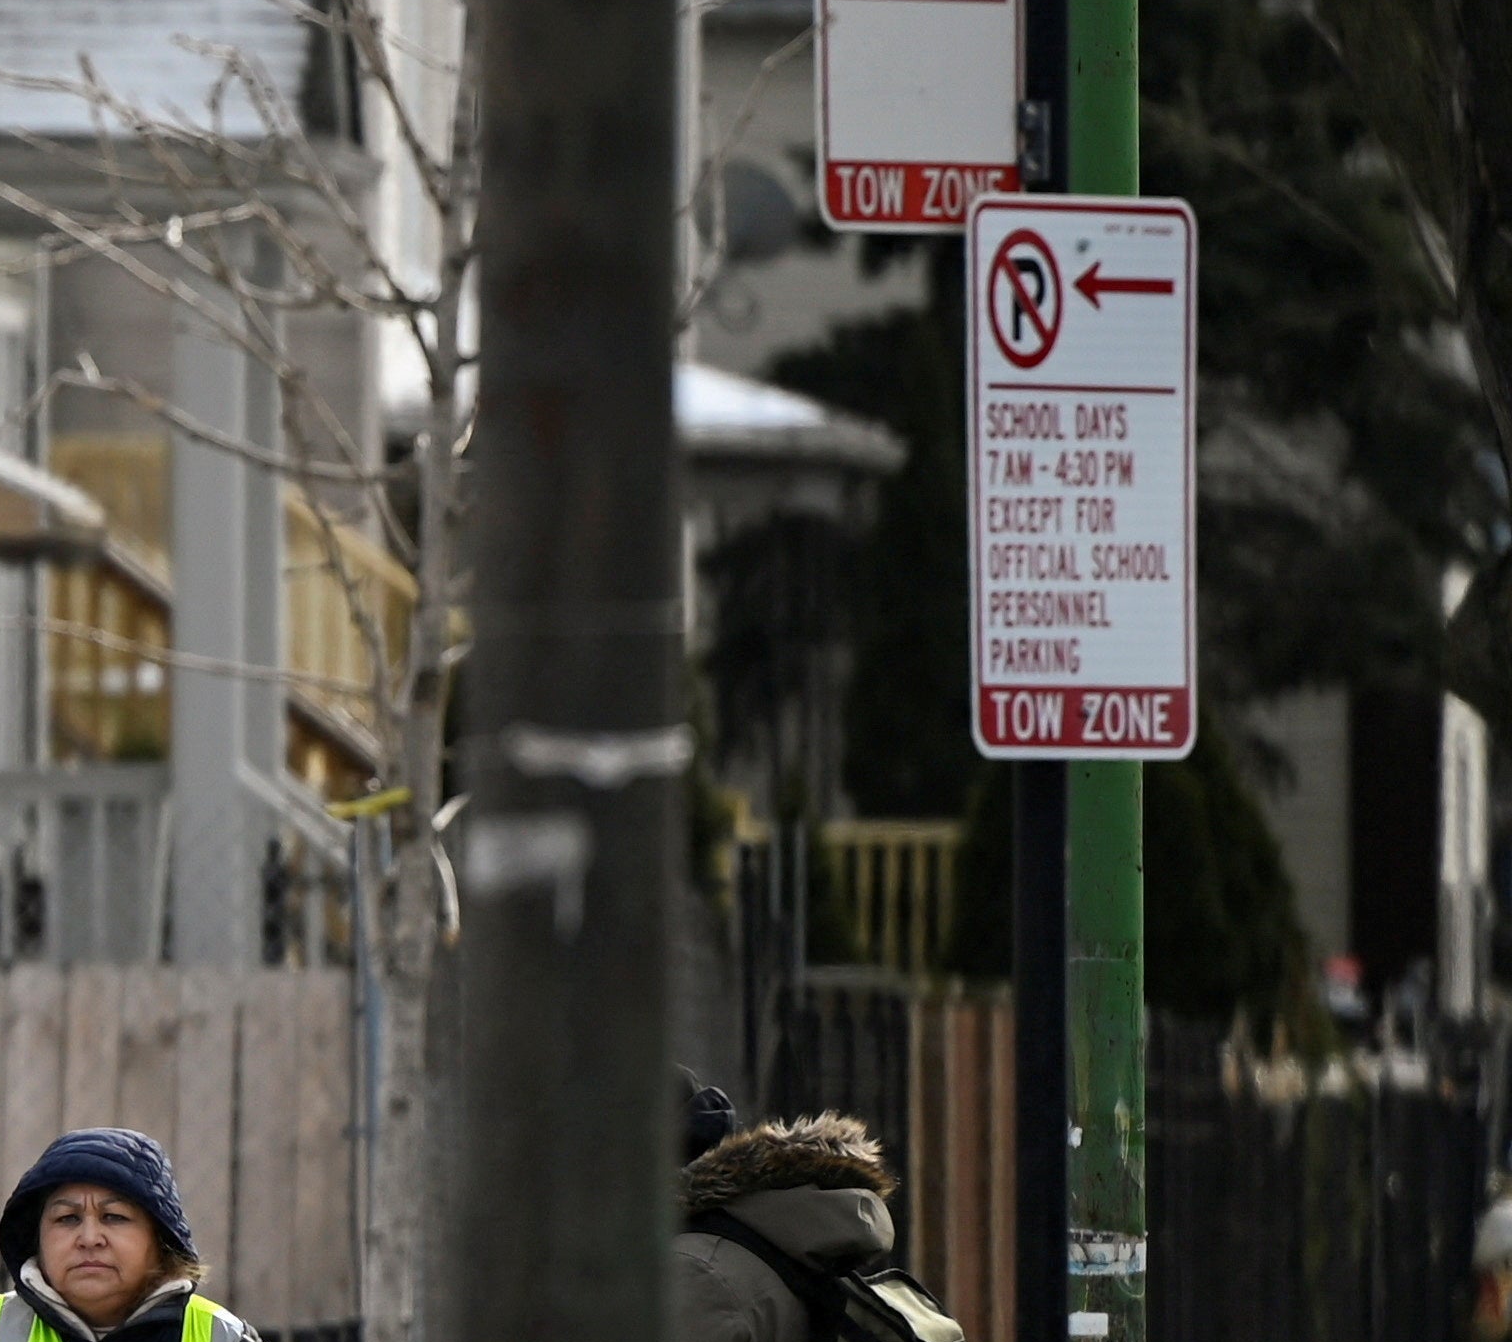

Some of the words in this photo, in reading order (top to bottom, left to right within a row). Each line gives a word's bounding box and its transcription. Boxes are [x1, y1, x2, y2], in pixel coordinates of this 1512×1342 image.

[835, 166, 905, 217] TOW
[986, 402, 1064, 441] SCHOOL
[1075, 402, 1129, 441] DAYS
[1104, 450, 1135, 488] PM
[988, 496, 1063, 534] EXCEPT
[1075, 497, 1117, 534] FOR
[988, 543, 1081, 581] OFFICIAL
[1091, 543, 1170, 582] SCHOOL
[989, 590, 1112, 628] PERSONNEL
[989, 637, 1081, 675] PARKING
[989, 691, 1064, 741] TOW
[1081, 692, 1174, 743] ZONE
